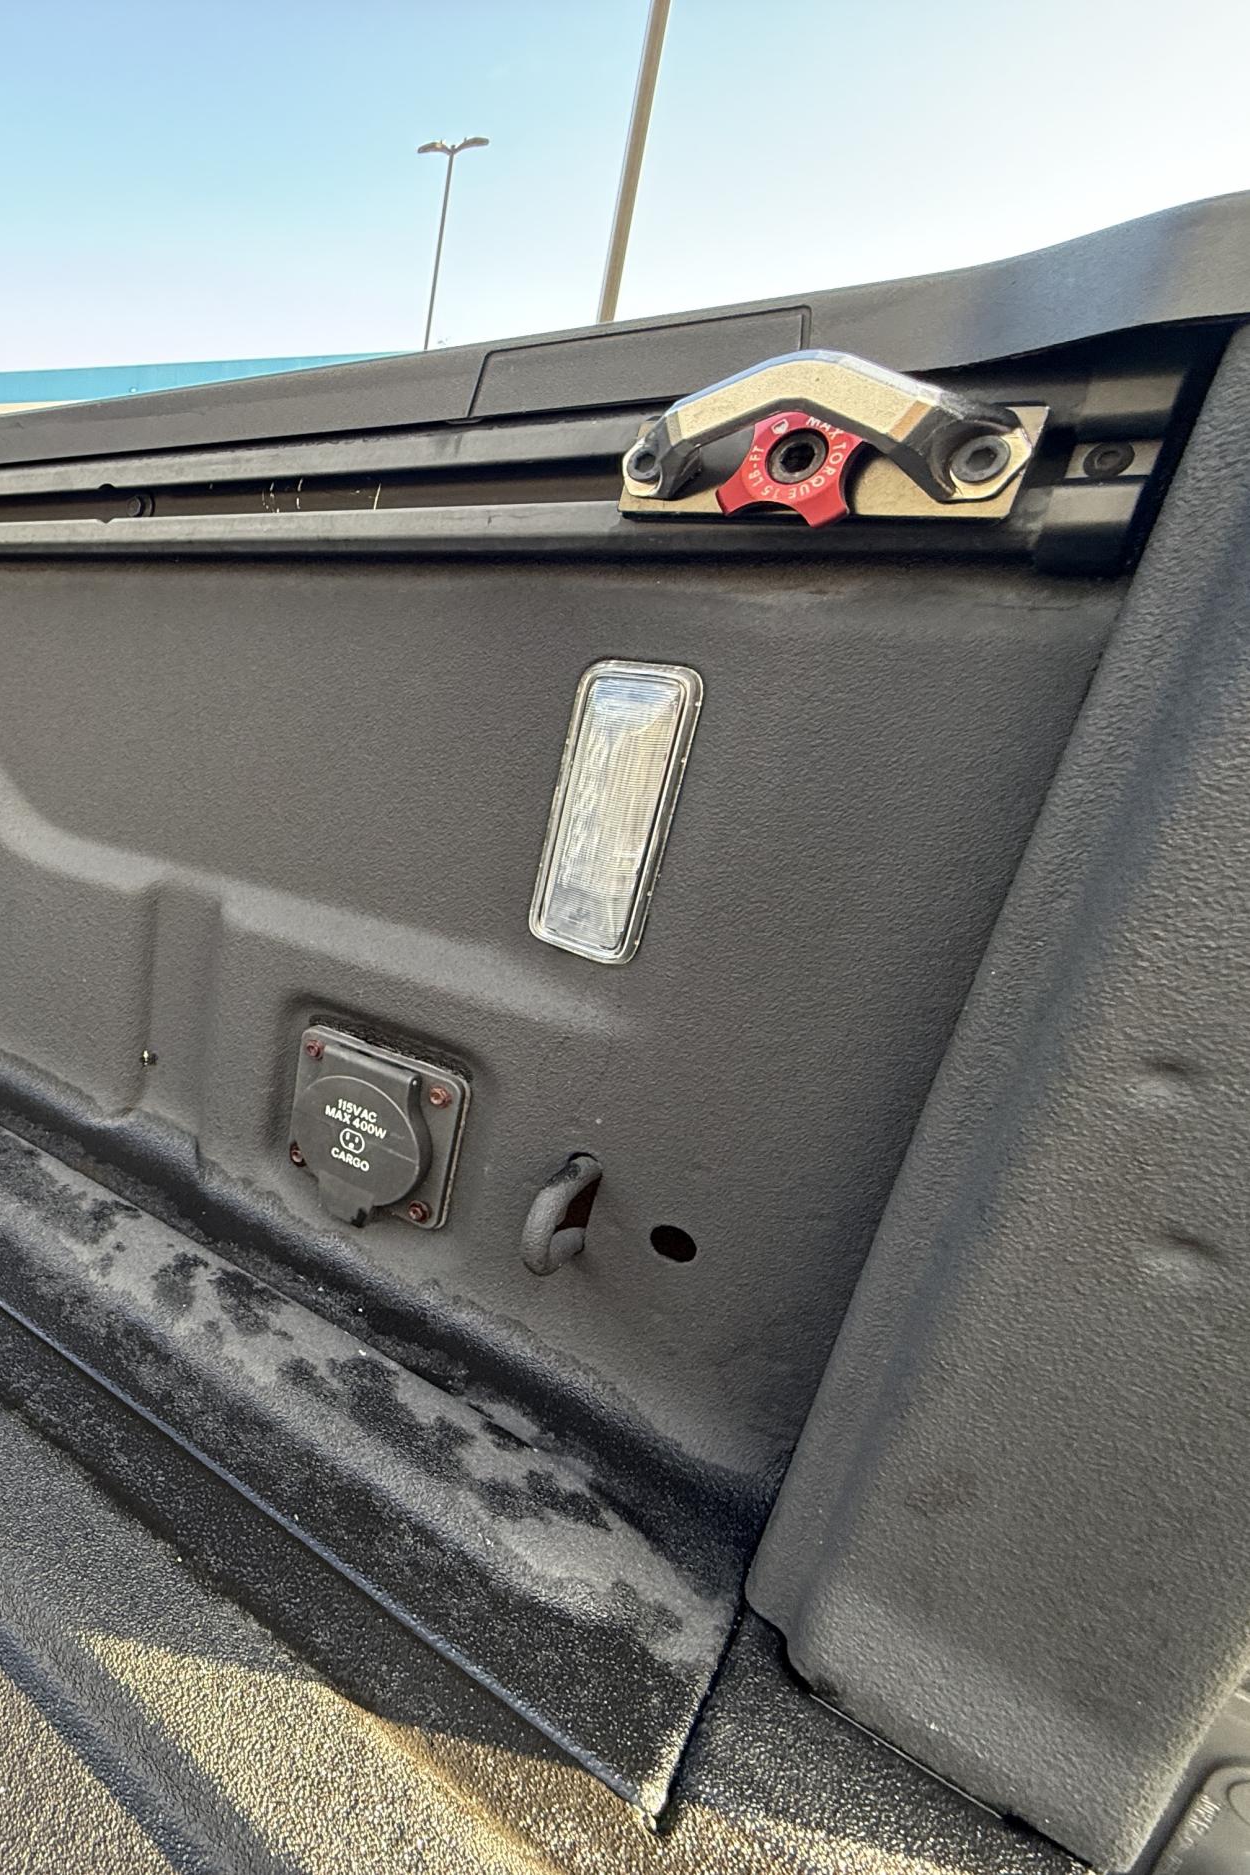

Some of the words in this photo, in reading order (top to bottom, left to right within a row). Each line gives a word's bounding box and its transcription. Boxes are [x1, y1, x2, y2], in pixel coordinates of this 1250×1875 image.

[806, 416, 844, 440] MAX
[748, 445, 765, 487] LB-FT
[788, 442, 847, 500] TORQUE
[325, 1105, 351, 1125] MAX
[352, 1118, 387, 1139] 400W
[338, 1098, 378, 1122] 115VAC
[331, 1147, 370, 1173] CARGO
